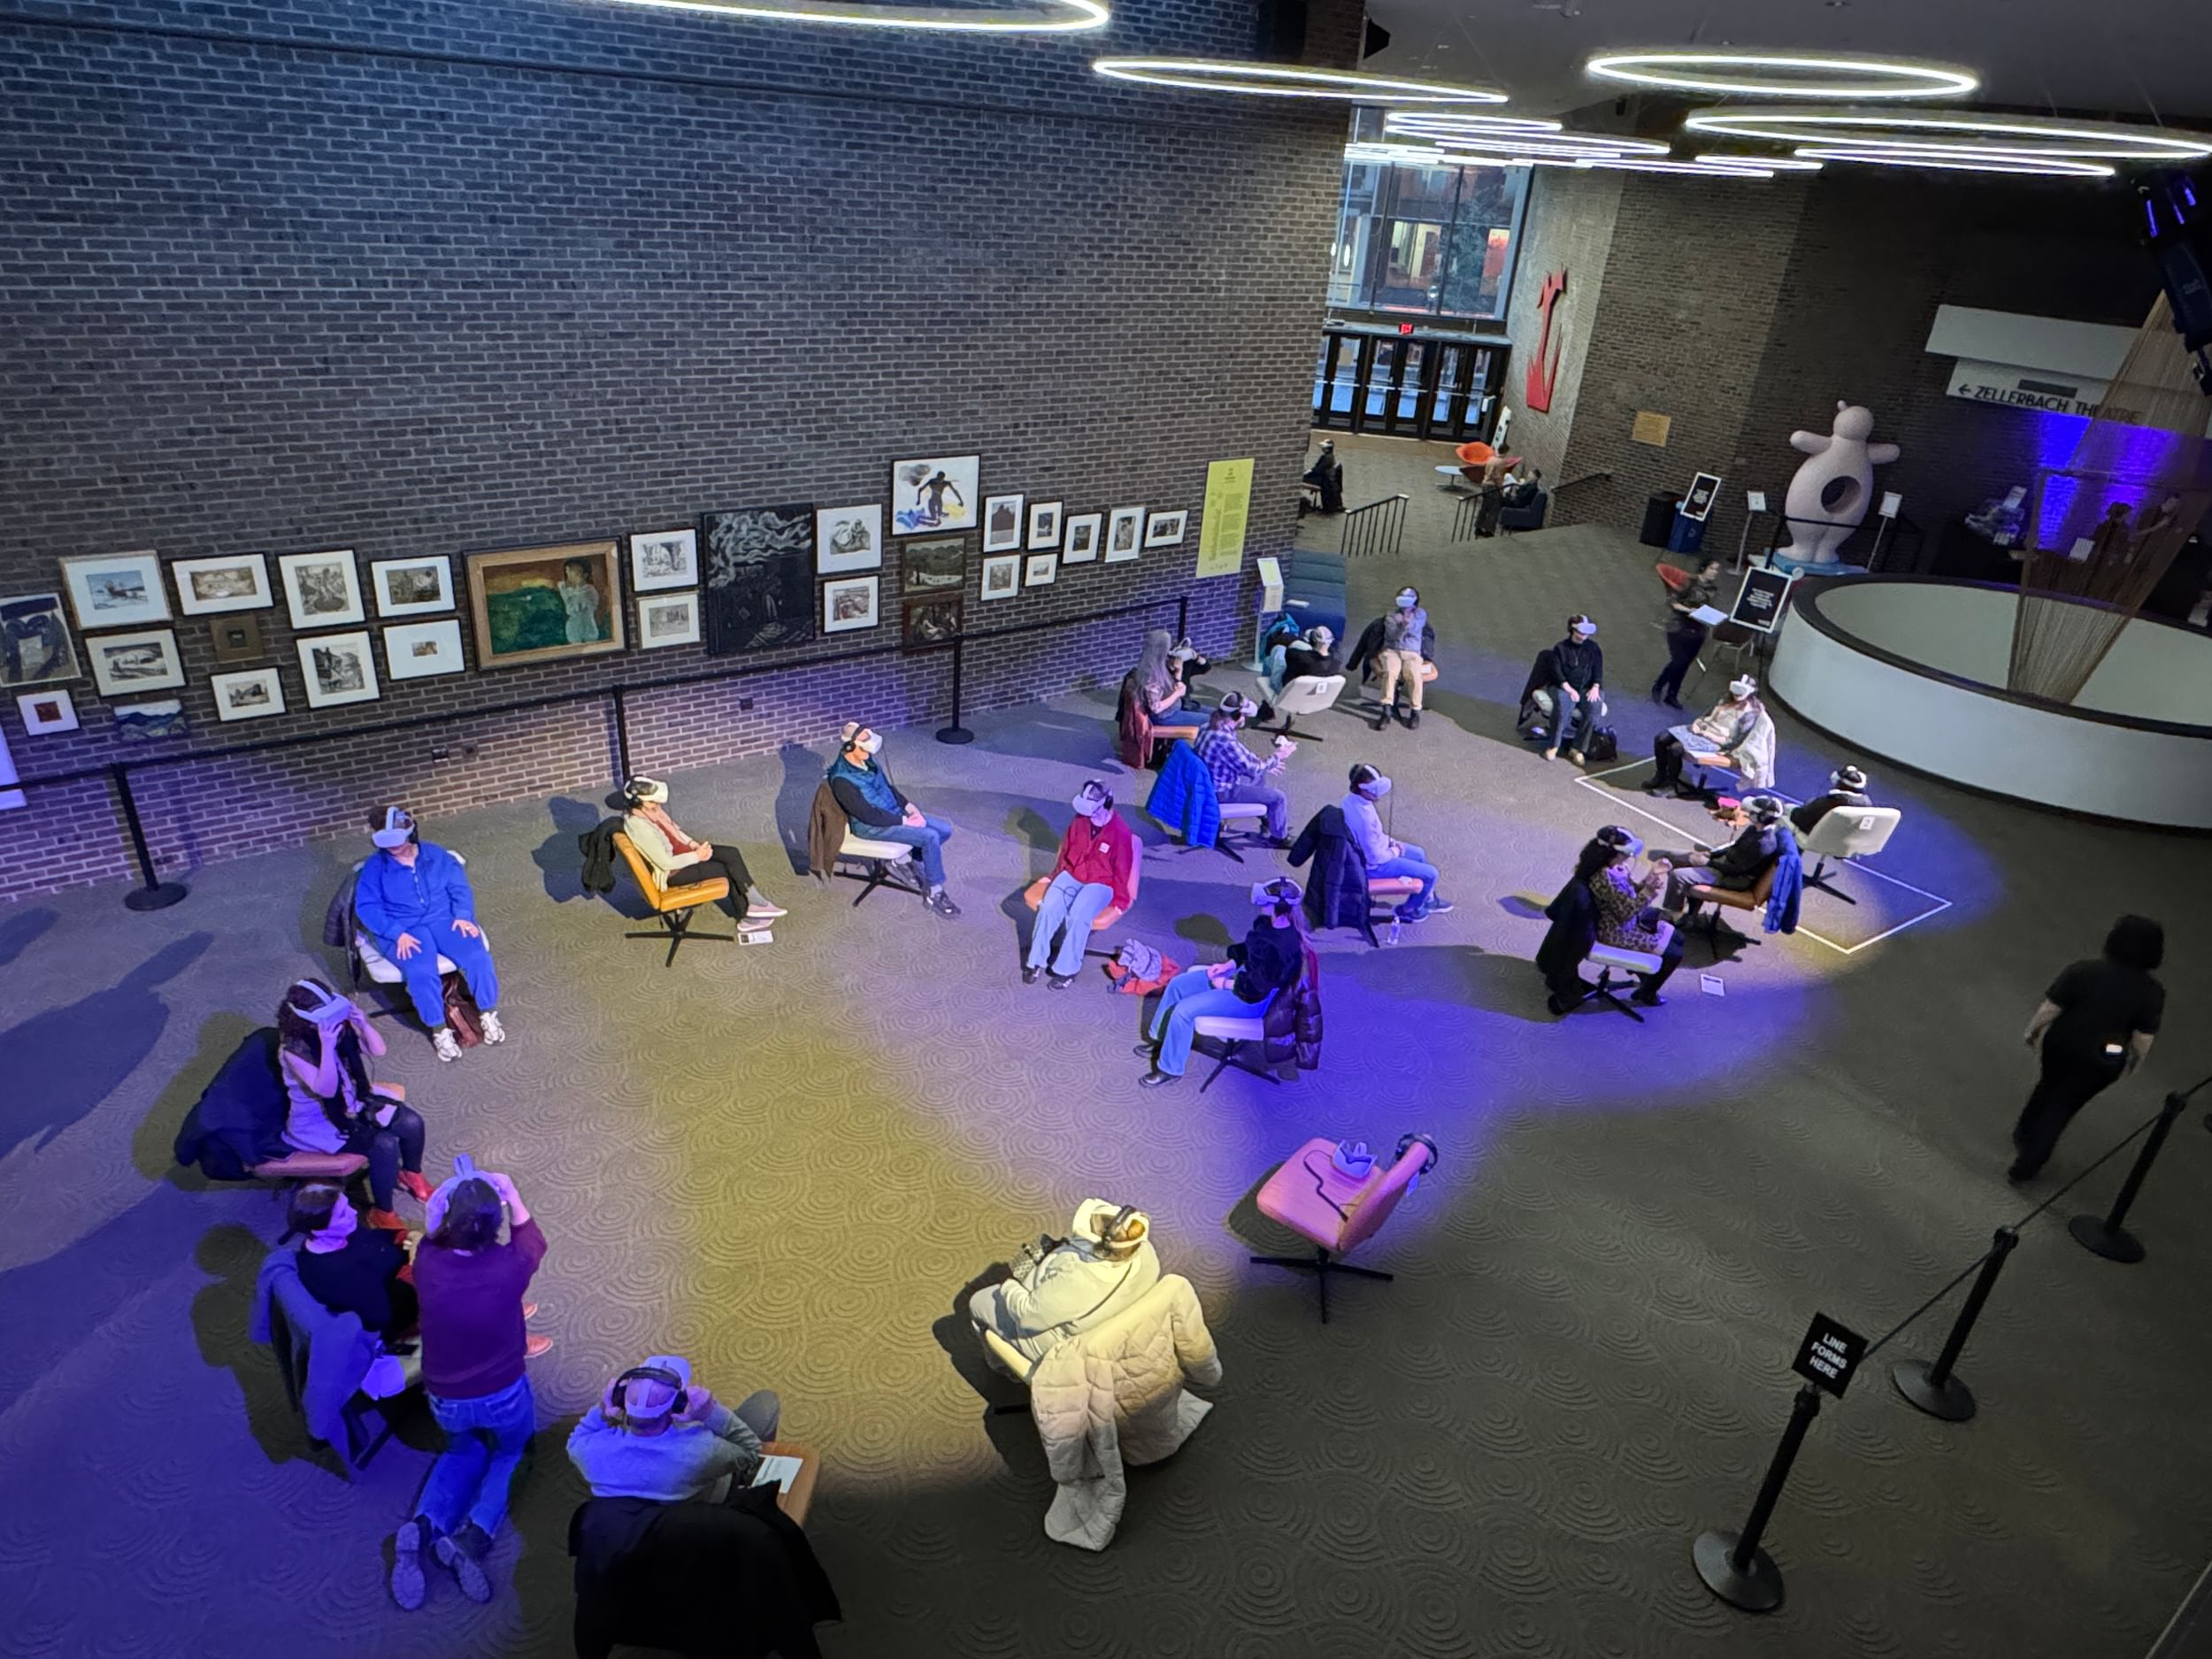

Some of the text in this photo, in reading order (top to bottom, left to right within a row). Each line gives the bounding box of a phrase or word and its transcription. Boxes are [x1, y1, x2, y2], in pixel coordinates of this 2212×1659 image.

[1974, 386, 2069, 412] ZELLERBACH
[1811, 1341, 1847, 1369] FORMS
[1823, 1333, 1848, 1354] LINE
[1809, 1356, 1839, 1379] HERE
